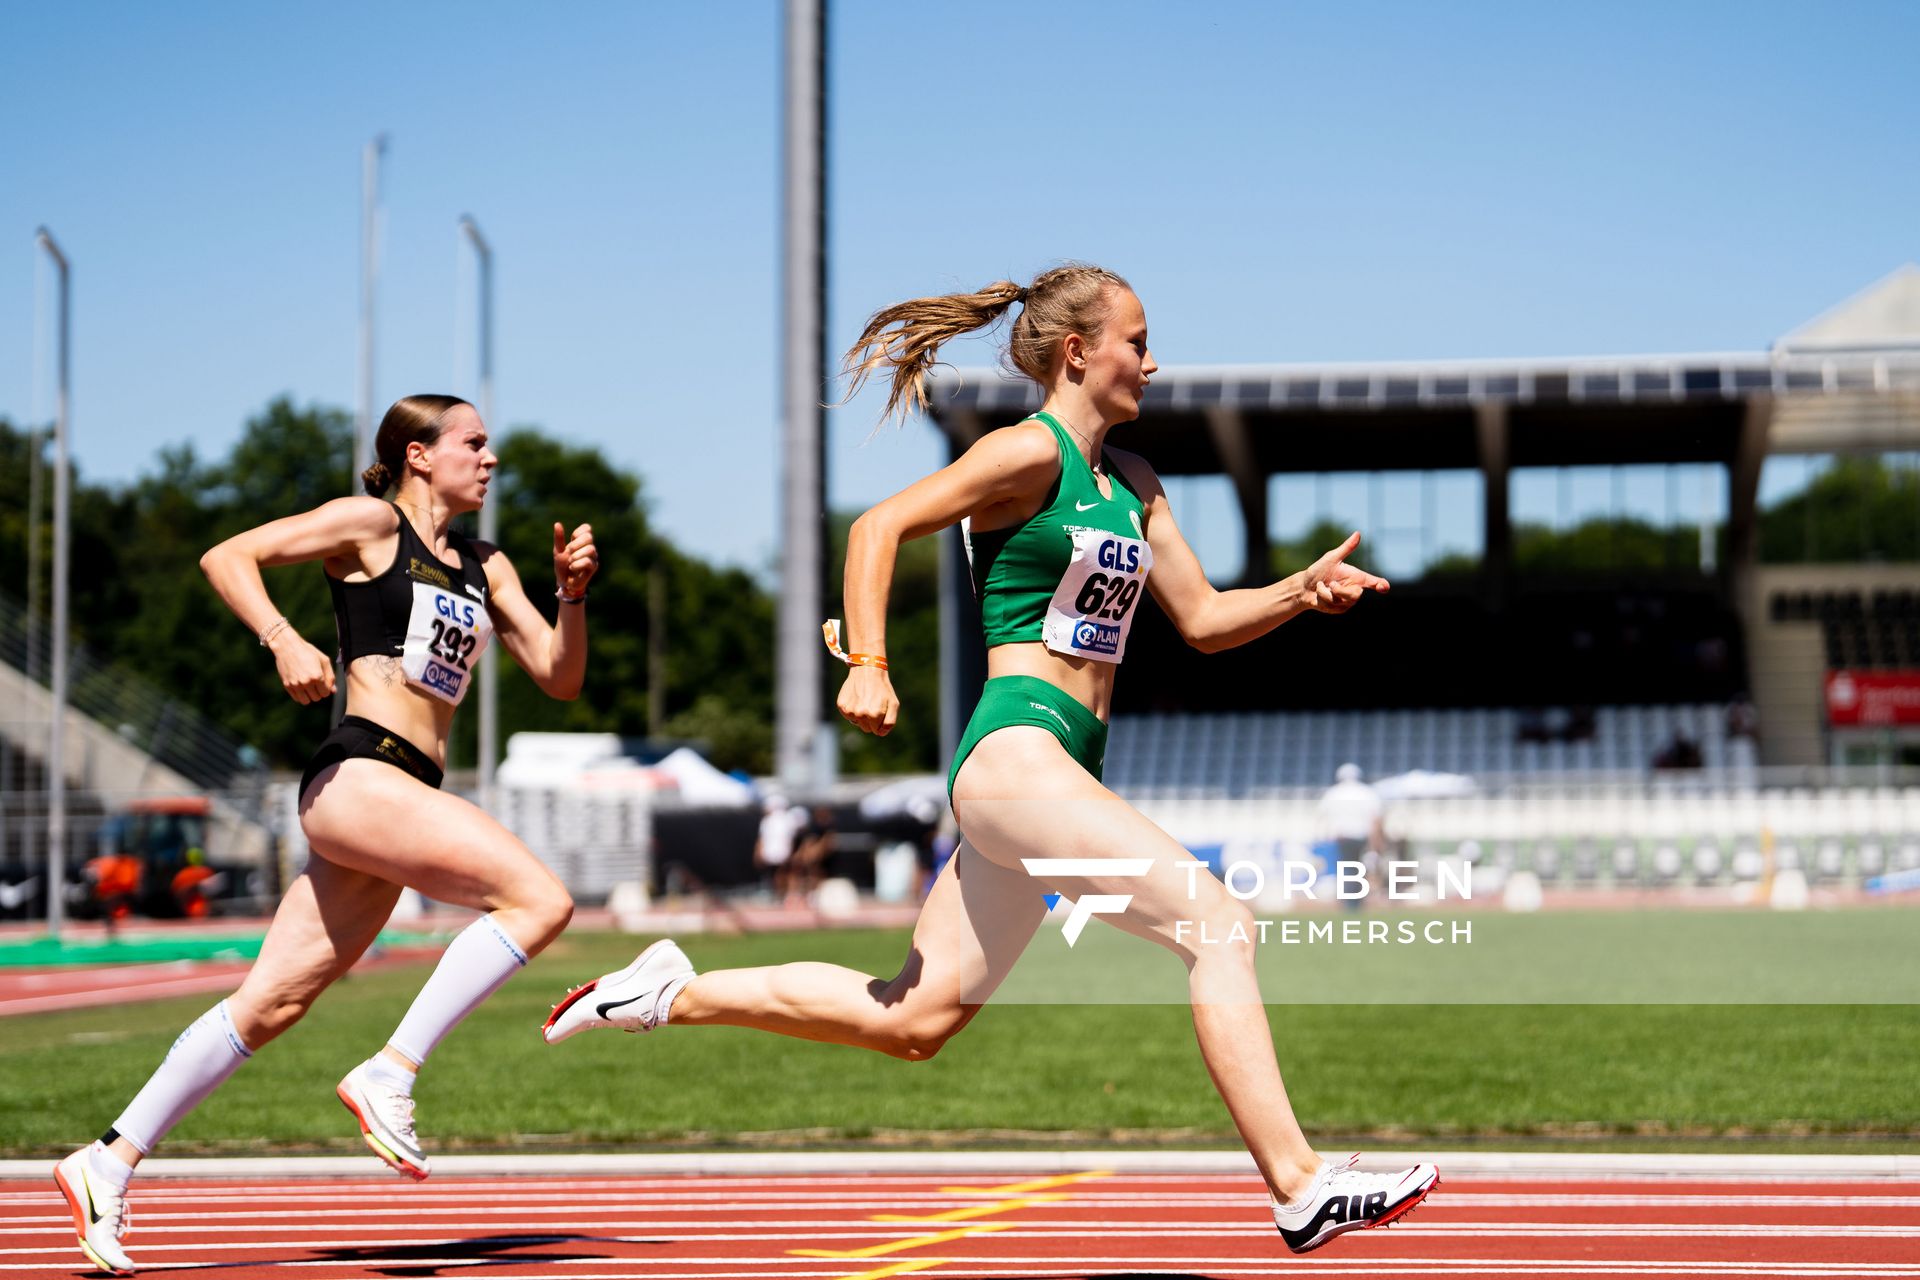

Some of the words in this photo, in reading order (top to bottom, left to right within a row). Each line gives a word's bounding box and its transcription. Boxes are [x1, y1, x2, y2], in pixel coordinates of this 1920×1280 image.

[1075, 572, 1140, 621] 629
[429, 618, 476, 670] 292
[1097, 630, 1119, 644] PLAN
[439, 670, 460, 689] PLAN
[1312, 1191, 1388, 1230] AIR
